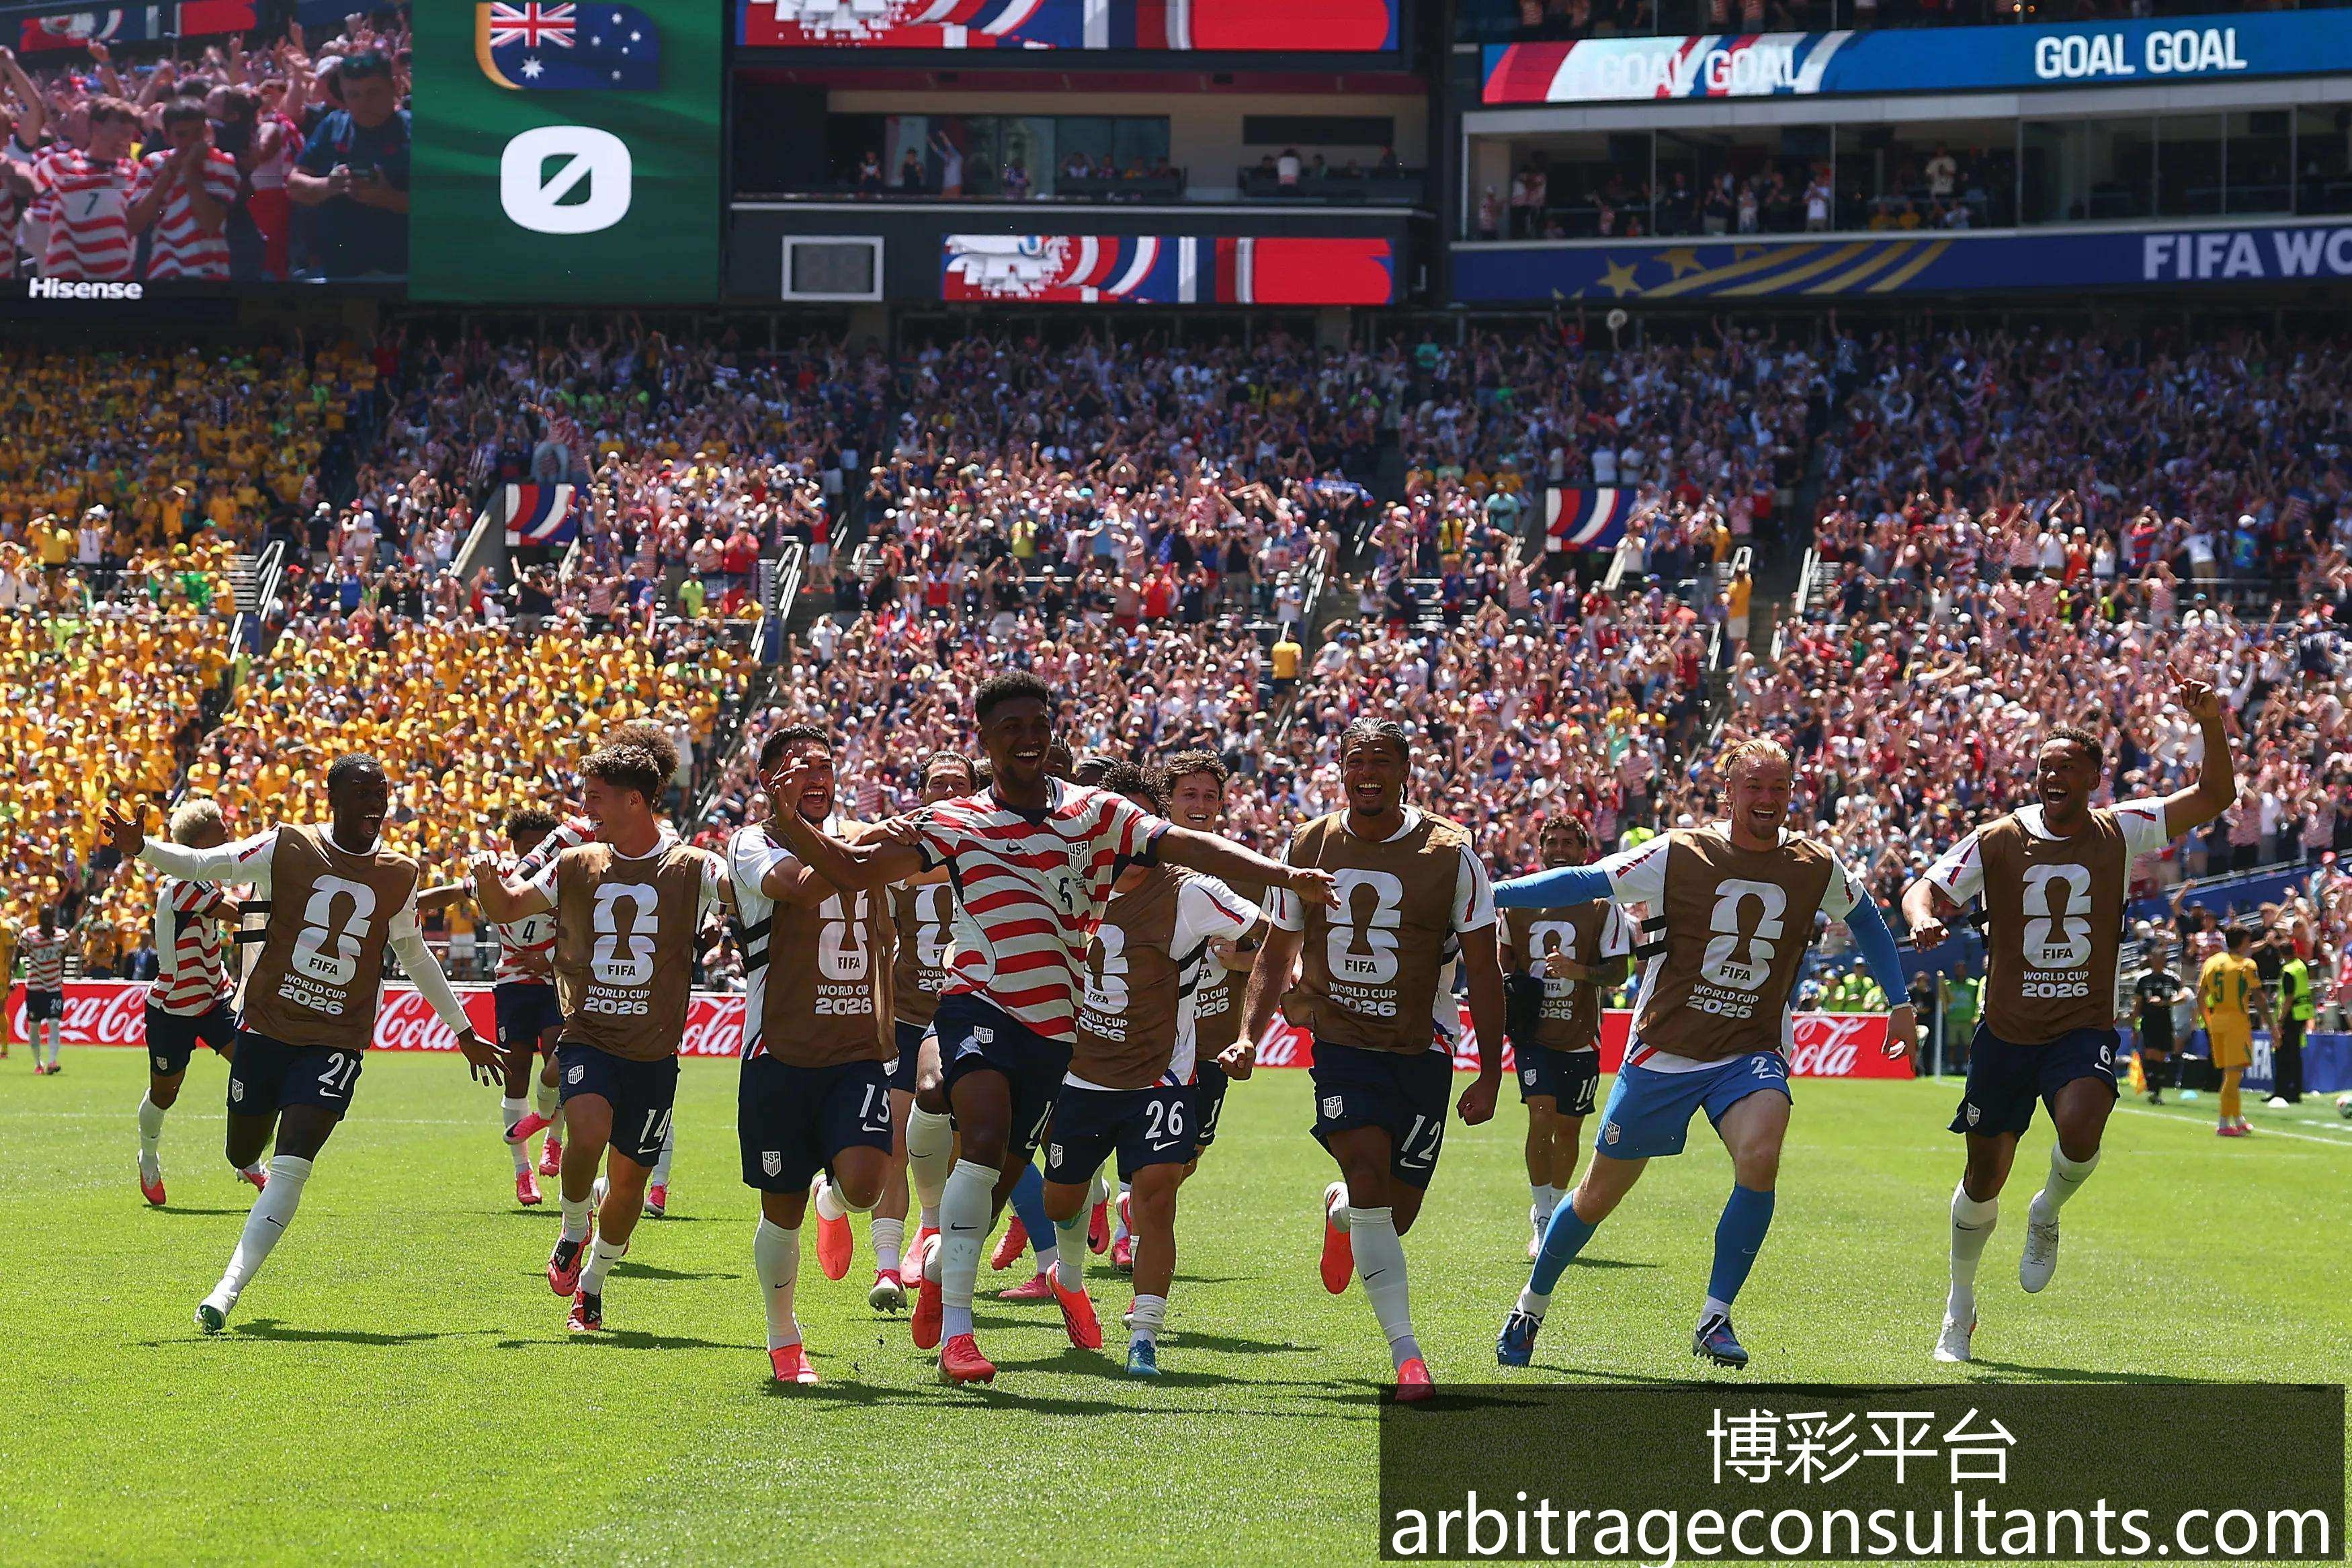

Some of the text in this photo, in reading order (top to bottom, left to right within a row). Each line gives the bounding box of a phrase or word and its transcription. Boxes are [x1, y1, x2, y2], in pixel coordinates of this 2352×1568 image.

[2035, 28, 2248, 79] GOAL GOAL
[1599, 45, 1803, 91] GOAL GOAL
[500, 125, 632, 234] 0
[84, 192, 98, 215] 7
[2144, 232, 2265, 279] FIFA
[28, 277, 143, 299] Hisense
[522, 920, 536, 943] 4
[838, 956, 860, 969] FIFA
[2043, 948, 2074, 959] FIFA
[308, 957, 339, 975] FIFA
[607, 964, 636, 976] FIFA
[917, 969, 946, 977] WOR
[1345, 959, 1378, 973] FIFA
[1719, 965, 1751, 981] FIFA
[2023, 971, 2089, 981] WORLD CUP
[284, 973, 347, 1000] WORLD CUP
[588, 985, 650, 999] WORLD CUP
[817, 984, 870, 996] WORLD CUP
[918, 978, 945, 991] 20
[1210, 986, 1229, 999] CUP
[1329, 982, 1397, 999] WORLD CUP
[1693, 984, 1759, 1004] WORLD CUP
[2022, 982, 2090, 998] 2026
[2214, 971, 2224, 1003] 5
[278, 984, 344, 1015] 2026
[583, 996, 649, 1015] 2026
[815, 997, 873, 1015] 2026
[1194, 998, 1230, 1020] 026
[1685, 995, 1753, 1019] 2026
[1081, 1007, 1128, 1028] ORLD CUP
[1539, 1007, 1572, 1020] 026
[681, 997, 746, 1055] ola
[1079, 1016, 1126, 1042] 026
[2100, 1045, 2111, 1065] 6
[318, 1053, 356, 1090] 21
[1577, 1076, 1597, 1103] 10
[859, 1083, 890, 1123] 15
[640, 1108, 671, 1143] 14
[1145, 1100, 1184, 1139] 26
[1401, 1115, 1441, 1161] 12
